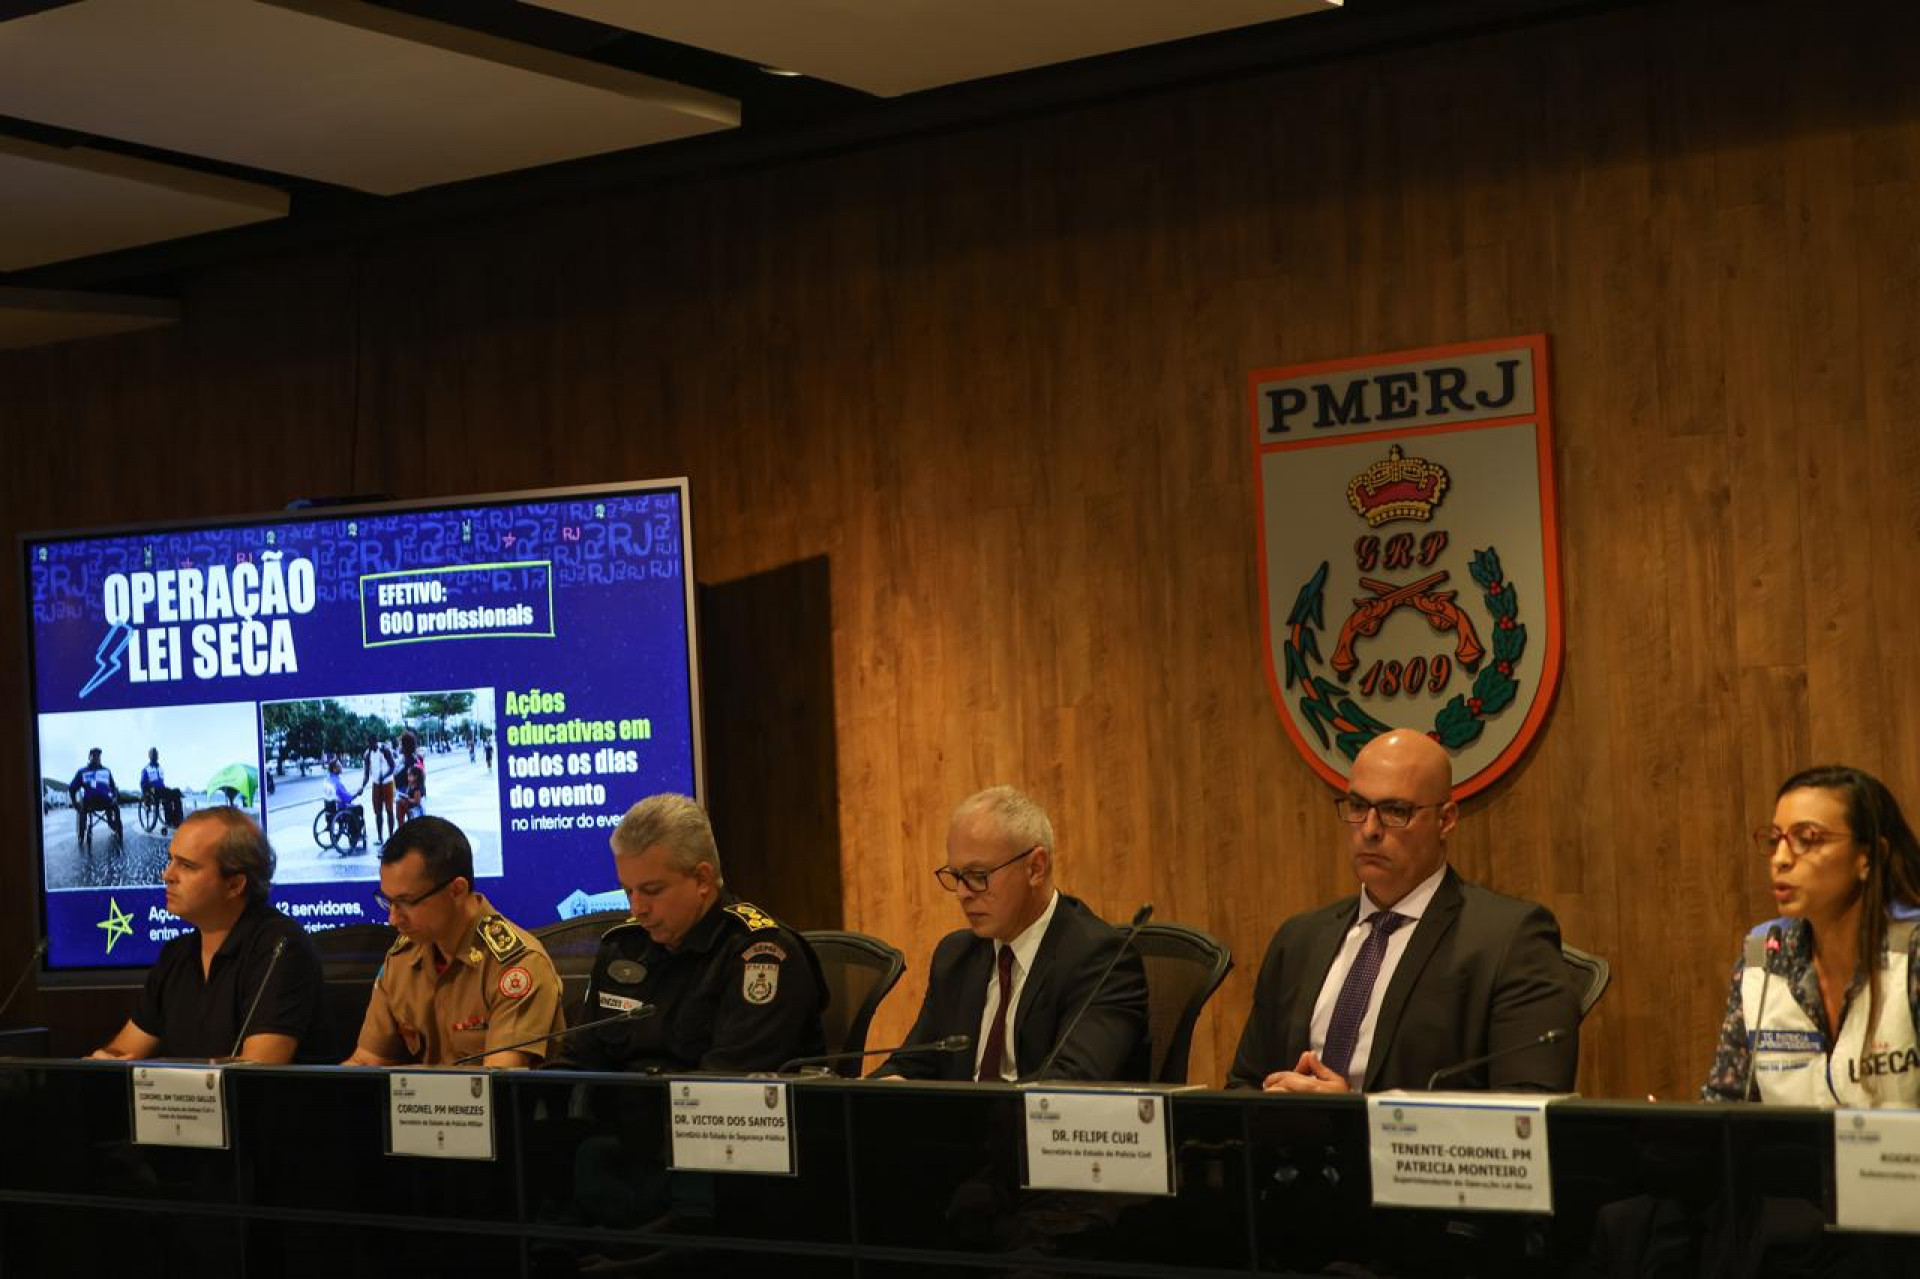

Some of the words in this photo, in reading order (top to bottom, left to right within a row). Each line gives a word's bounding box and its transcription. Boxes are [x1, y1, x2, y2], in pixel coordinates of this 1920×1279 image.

[1265, 359, 1522, 434] PMERJ
[563, 527, 580, 541] RJ
[608, 520, 652, 557] RJ
[1354, 531, 1449, 572] GRP
[103, 550, 316, 626] OPERAÇÃO
[377, 580, 448, 608] EFETIVO:
[379, 610, 414, 635] 600
[416, 603, 534, 633] profissionais
[129, 626, 182, 683] LEI
[191, 618, 298, 679] SECA
[1358, 654, 1452, 697] 1809
[505, 688, 566, 720] Ações
[506, 718, 617, 746] educativas
[618, 718, 651, 740] em
[507, 751, 565, 779] todos
[567, 752, 592, 776] os
[594, 748, 639, 774] dias
[509, 784, 535, 809] do
[538, 783, 607, 809] evento
[511, 818, 529, 831] no
[531, 813, 575, 830] interior
[576, 813, 595, 829] do
[291, 900, 365, 918] servidores,
[397, 1104, 432, 1114] CORONEL
[434, 1105, 446, 1114] PM
[448, 1105, 484, 1115] MENEZES
[674, 1114, 689, 1125] DR.
[692, 1115, 725, 1126] VICTOR
[727, 1116, 746, 1126] DOS
[748, 1116, 785, 1127] SANTOS
[1052, 1129, 1070, 1142] DR.
[1072, 1129, 1108, 1144] FELIPE
[1111, 1131, 1139, 1145] CURI
[1391, 1142, 1508, 1160] TENENTE-CORONEL
[1512, 1148, 1532, 1161] PM
[1396, 1160, 1455, 1175] PATRICIA
[1458, 1163, 1527, 1178] MONTEIRO
